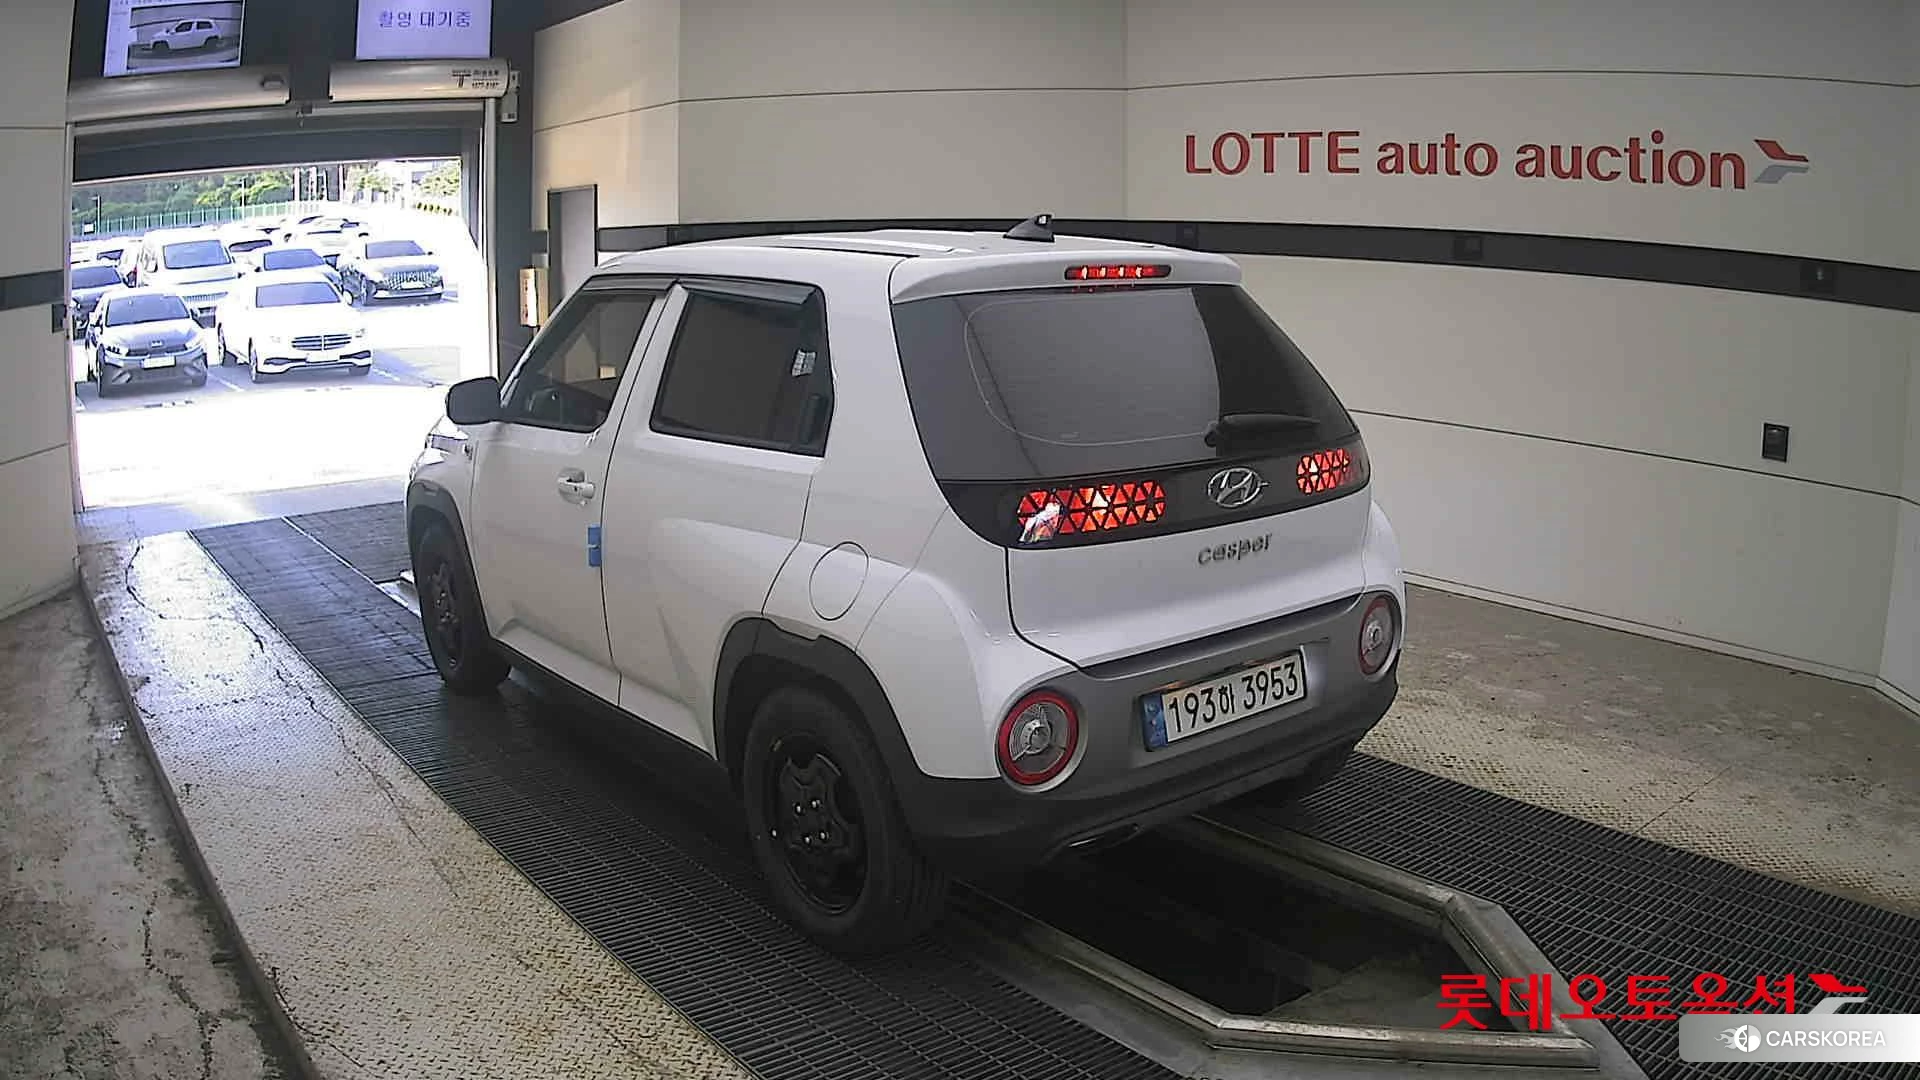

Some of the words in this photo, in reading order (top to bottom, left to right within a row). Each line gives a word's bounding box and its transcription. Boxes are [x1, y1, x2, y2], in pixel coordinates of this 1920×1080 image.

[419, 10, 471, 28] 대기중
[1185, 130, 1361, 176] LOTTE
[1376, 132, 1499, 178] auto
[1514, 129, 1746, 190] auction
[1168, 683, 1236, 734] 193하
[1241, 661, 1299, 711] 3953
